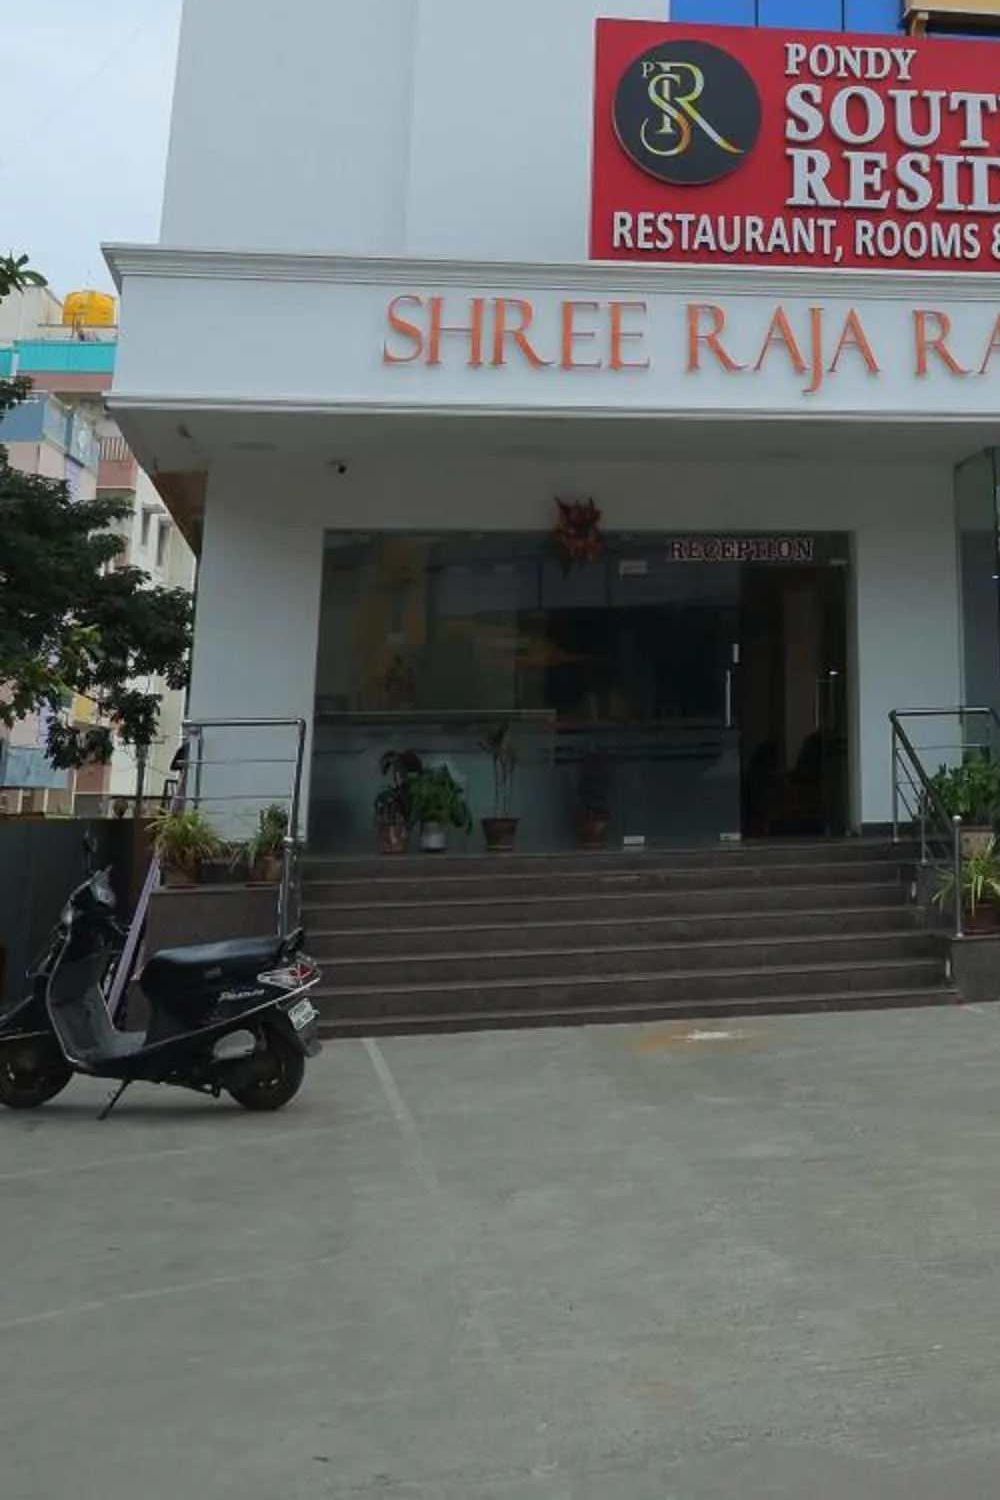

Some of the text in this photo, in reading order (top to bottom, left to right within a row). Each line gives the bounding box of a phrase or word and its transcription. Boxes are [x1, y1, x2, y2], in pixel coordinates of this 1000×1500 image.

[784, 43, 917, 81] PONDY
[612, 211, 844, 264] RESTAURANT,
[855, 220, 981, 261] ROOMS
[382, 294, 651, 372] SHREE
[685, 302, 880, 394] RAJA
[668, 537, 815, 562] RECEPTION
